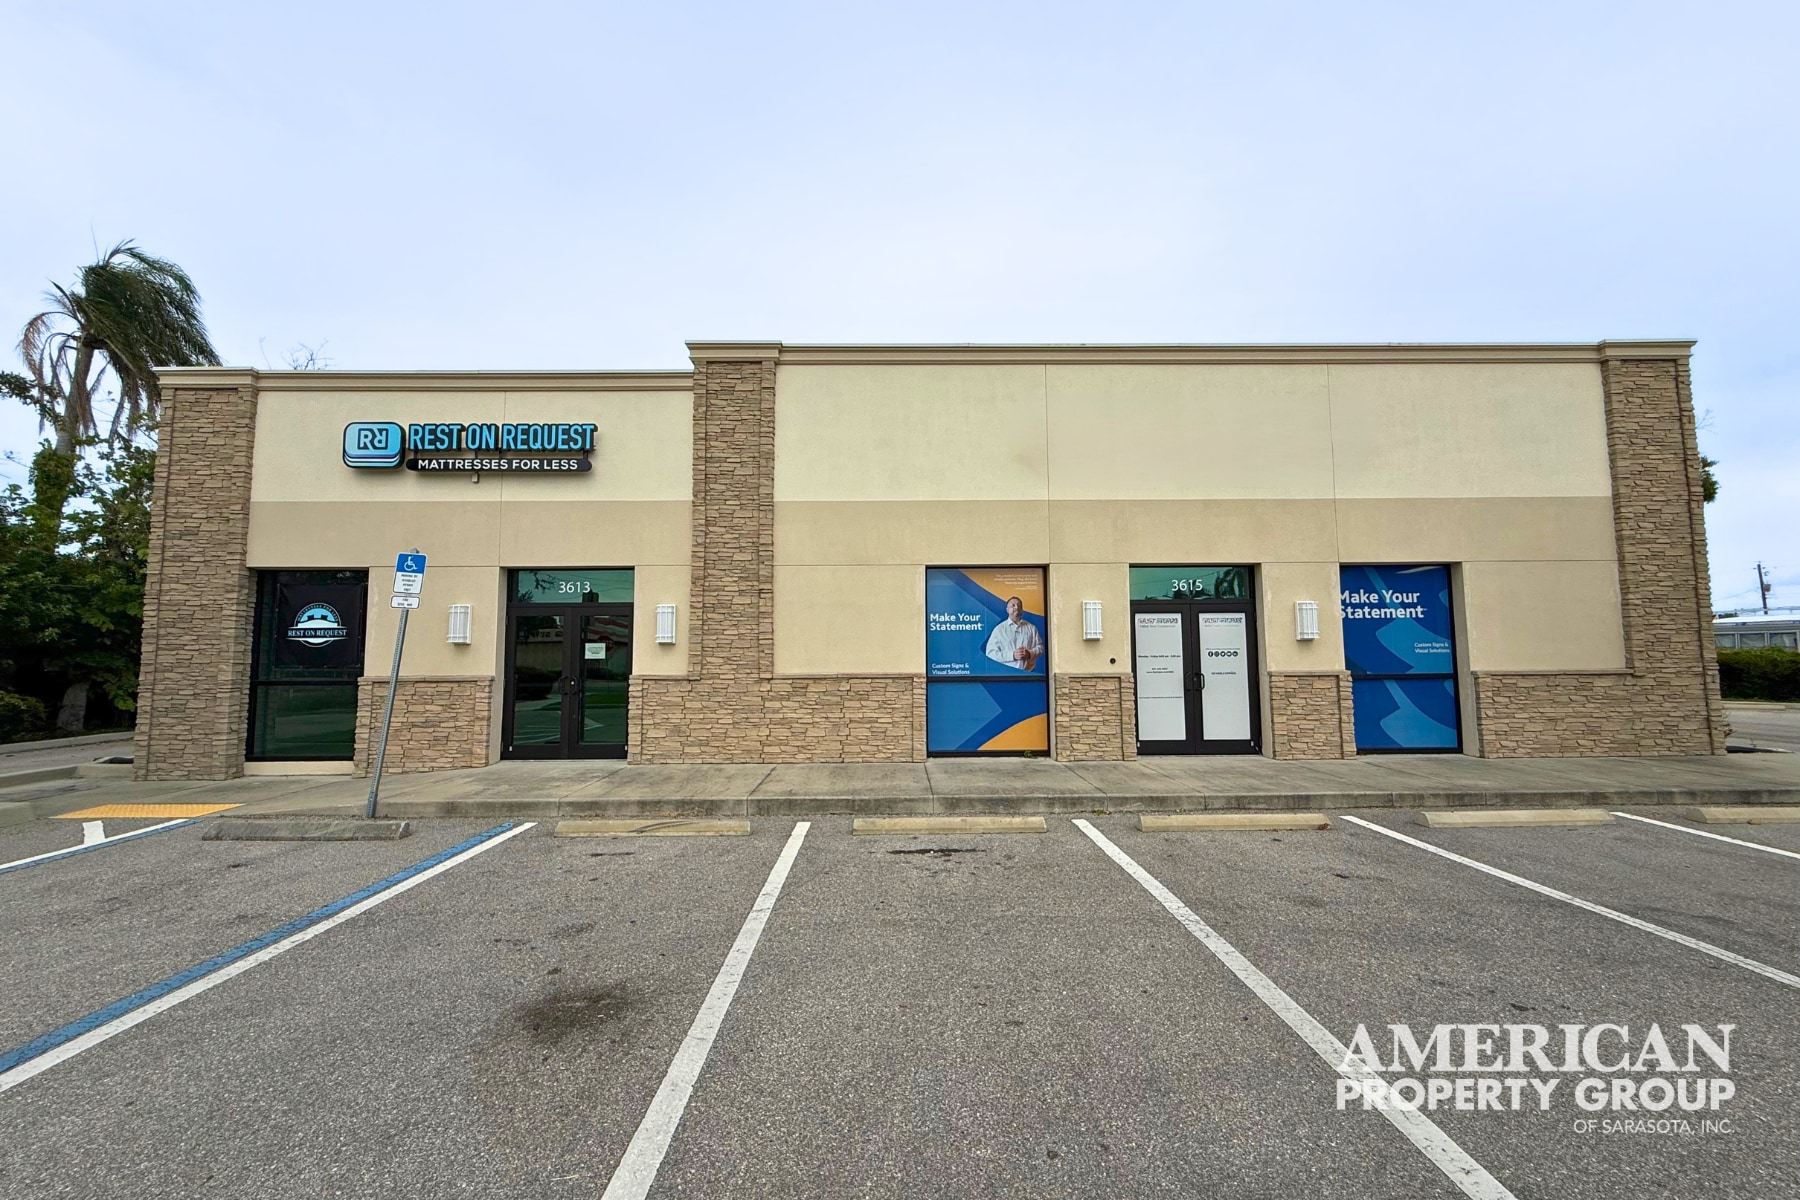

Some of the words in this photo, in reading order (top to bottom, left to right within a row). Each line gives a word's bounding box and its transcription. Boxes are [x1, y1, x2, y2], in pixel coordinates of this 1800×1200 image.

[409, 424, 461, 450] REST
[466, 424, 496, 450] ON
[502, 424, 595, 450] REQUEST
[418, 459, 508, 470] MATTRESSES
[512, 459, 540, 470] FOR
[544, 459, 578, 470] LESS
[558, 581, 591, 593] 3613
[1171, 579, 1203, 591] 3615
[1340, 589, 1379, 603] Make
[1381, 589, 1420, 603] Your
[930, 613, 956, 621] Make
[957, 613, 981, 622] Your
[1340, 605, 1425, 619] Statement
[930, 622, 983, 631] Statement
[316, 629, 347, 637] REQUEST
